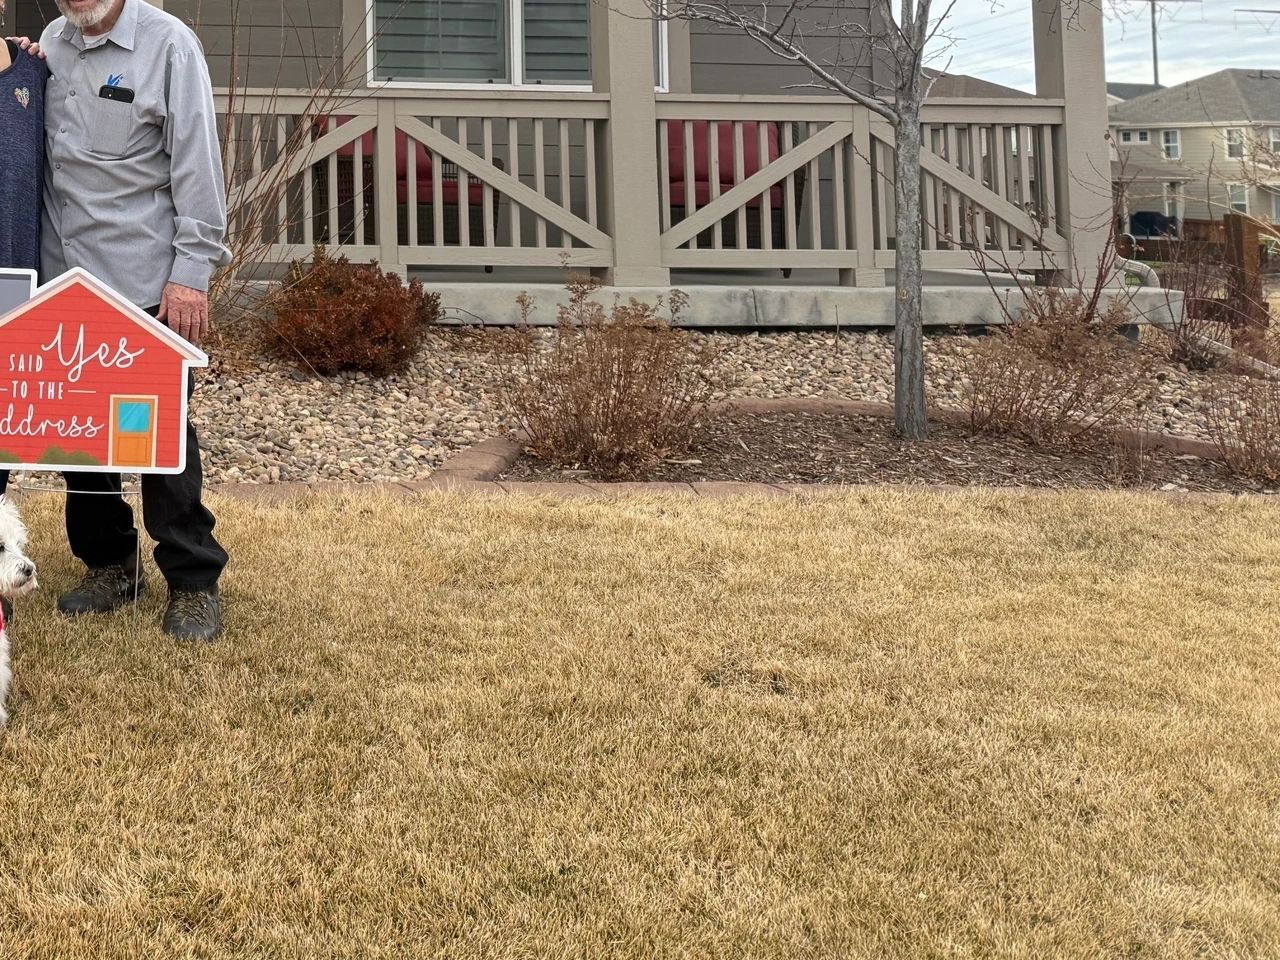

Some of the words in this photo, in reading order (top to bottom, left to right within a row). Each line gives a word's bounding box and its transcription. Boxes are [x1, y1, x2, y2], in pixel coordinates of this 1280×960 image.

[9, 353, 43, 373] SAID
[41, 322, 145, 383] Yes
[11, 380, 28, 399] TO
[38, 381, 64, 400] THE
